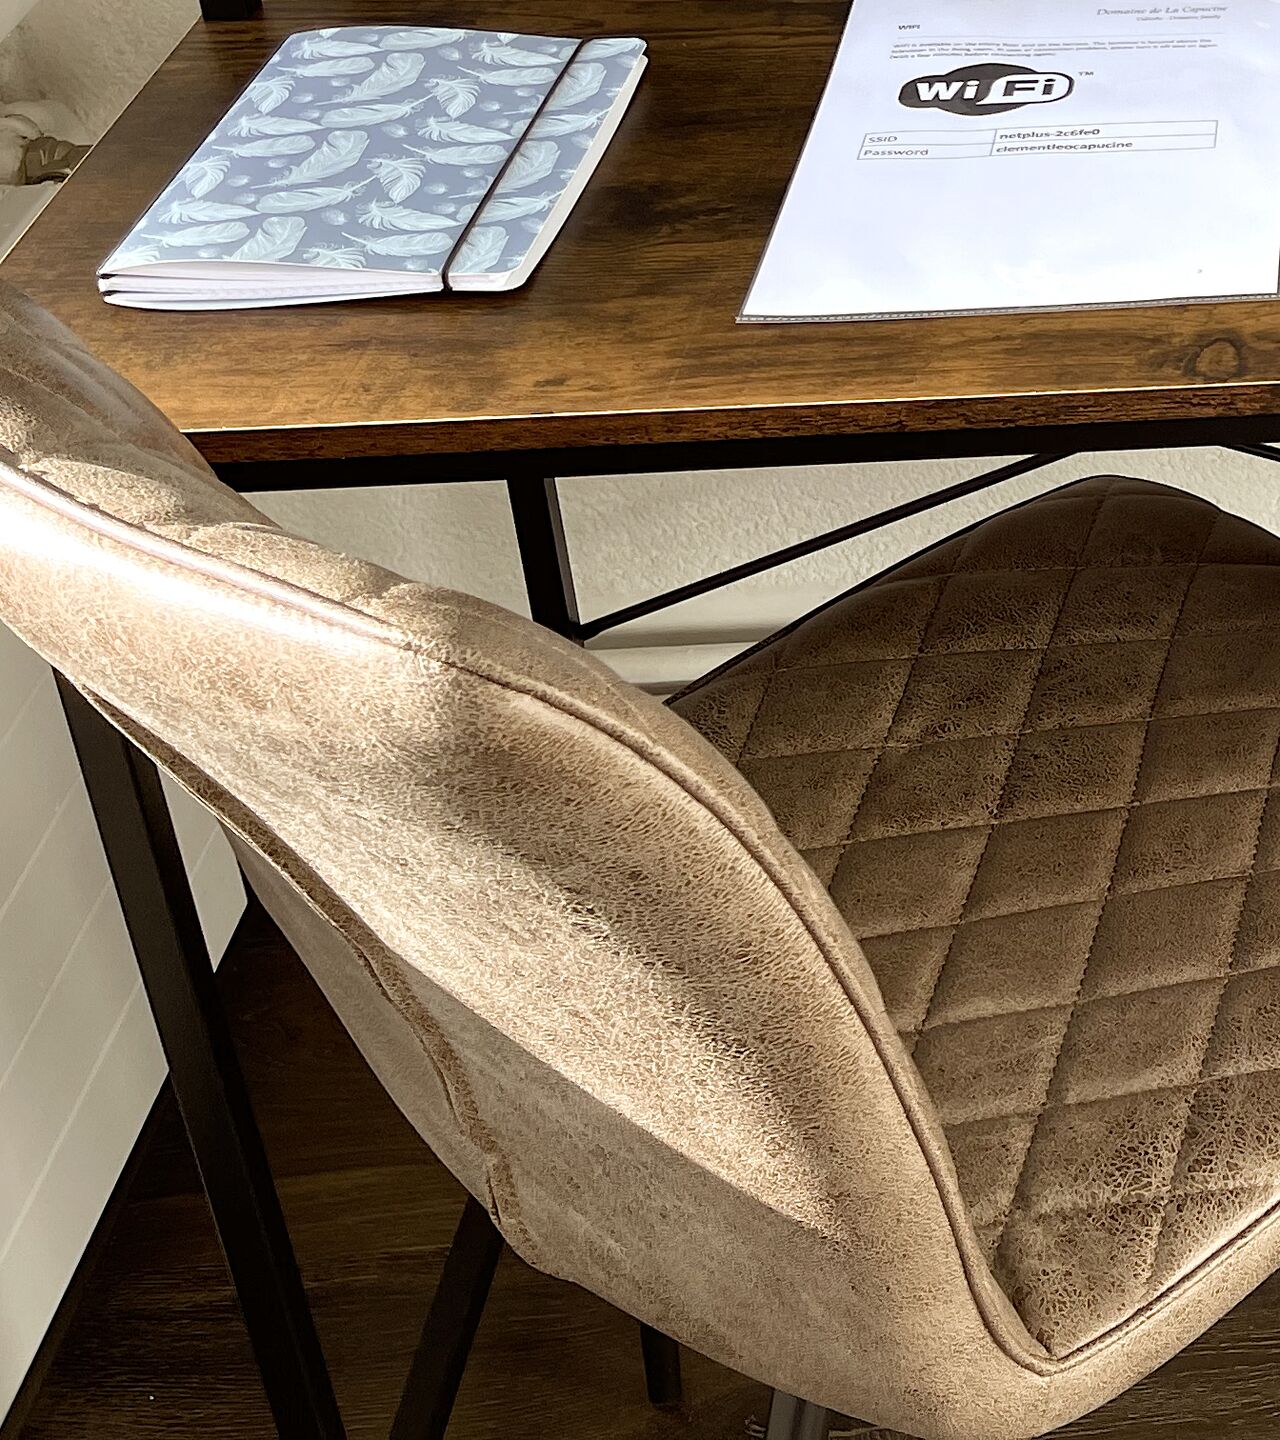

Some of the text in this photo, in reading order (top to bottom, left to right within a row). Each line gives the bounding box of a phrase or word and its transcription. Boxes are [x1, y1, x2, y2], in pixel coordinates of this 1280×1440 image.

[867, 134, 898, 144] SSID
[863, 141, 1134, 158] Password clementleocapucine
